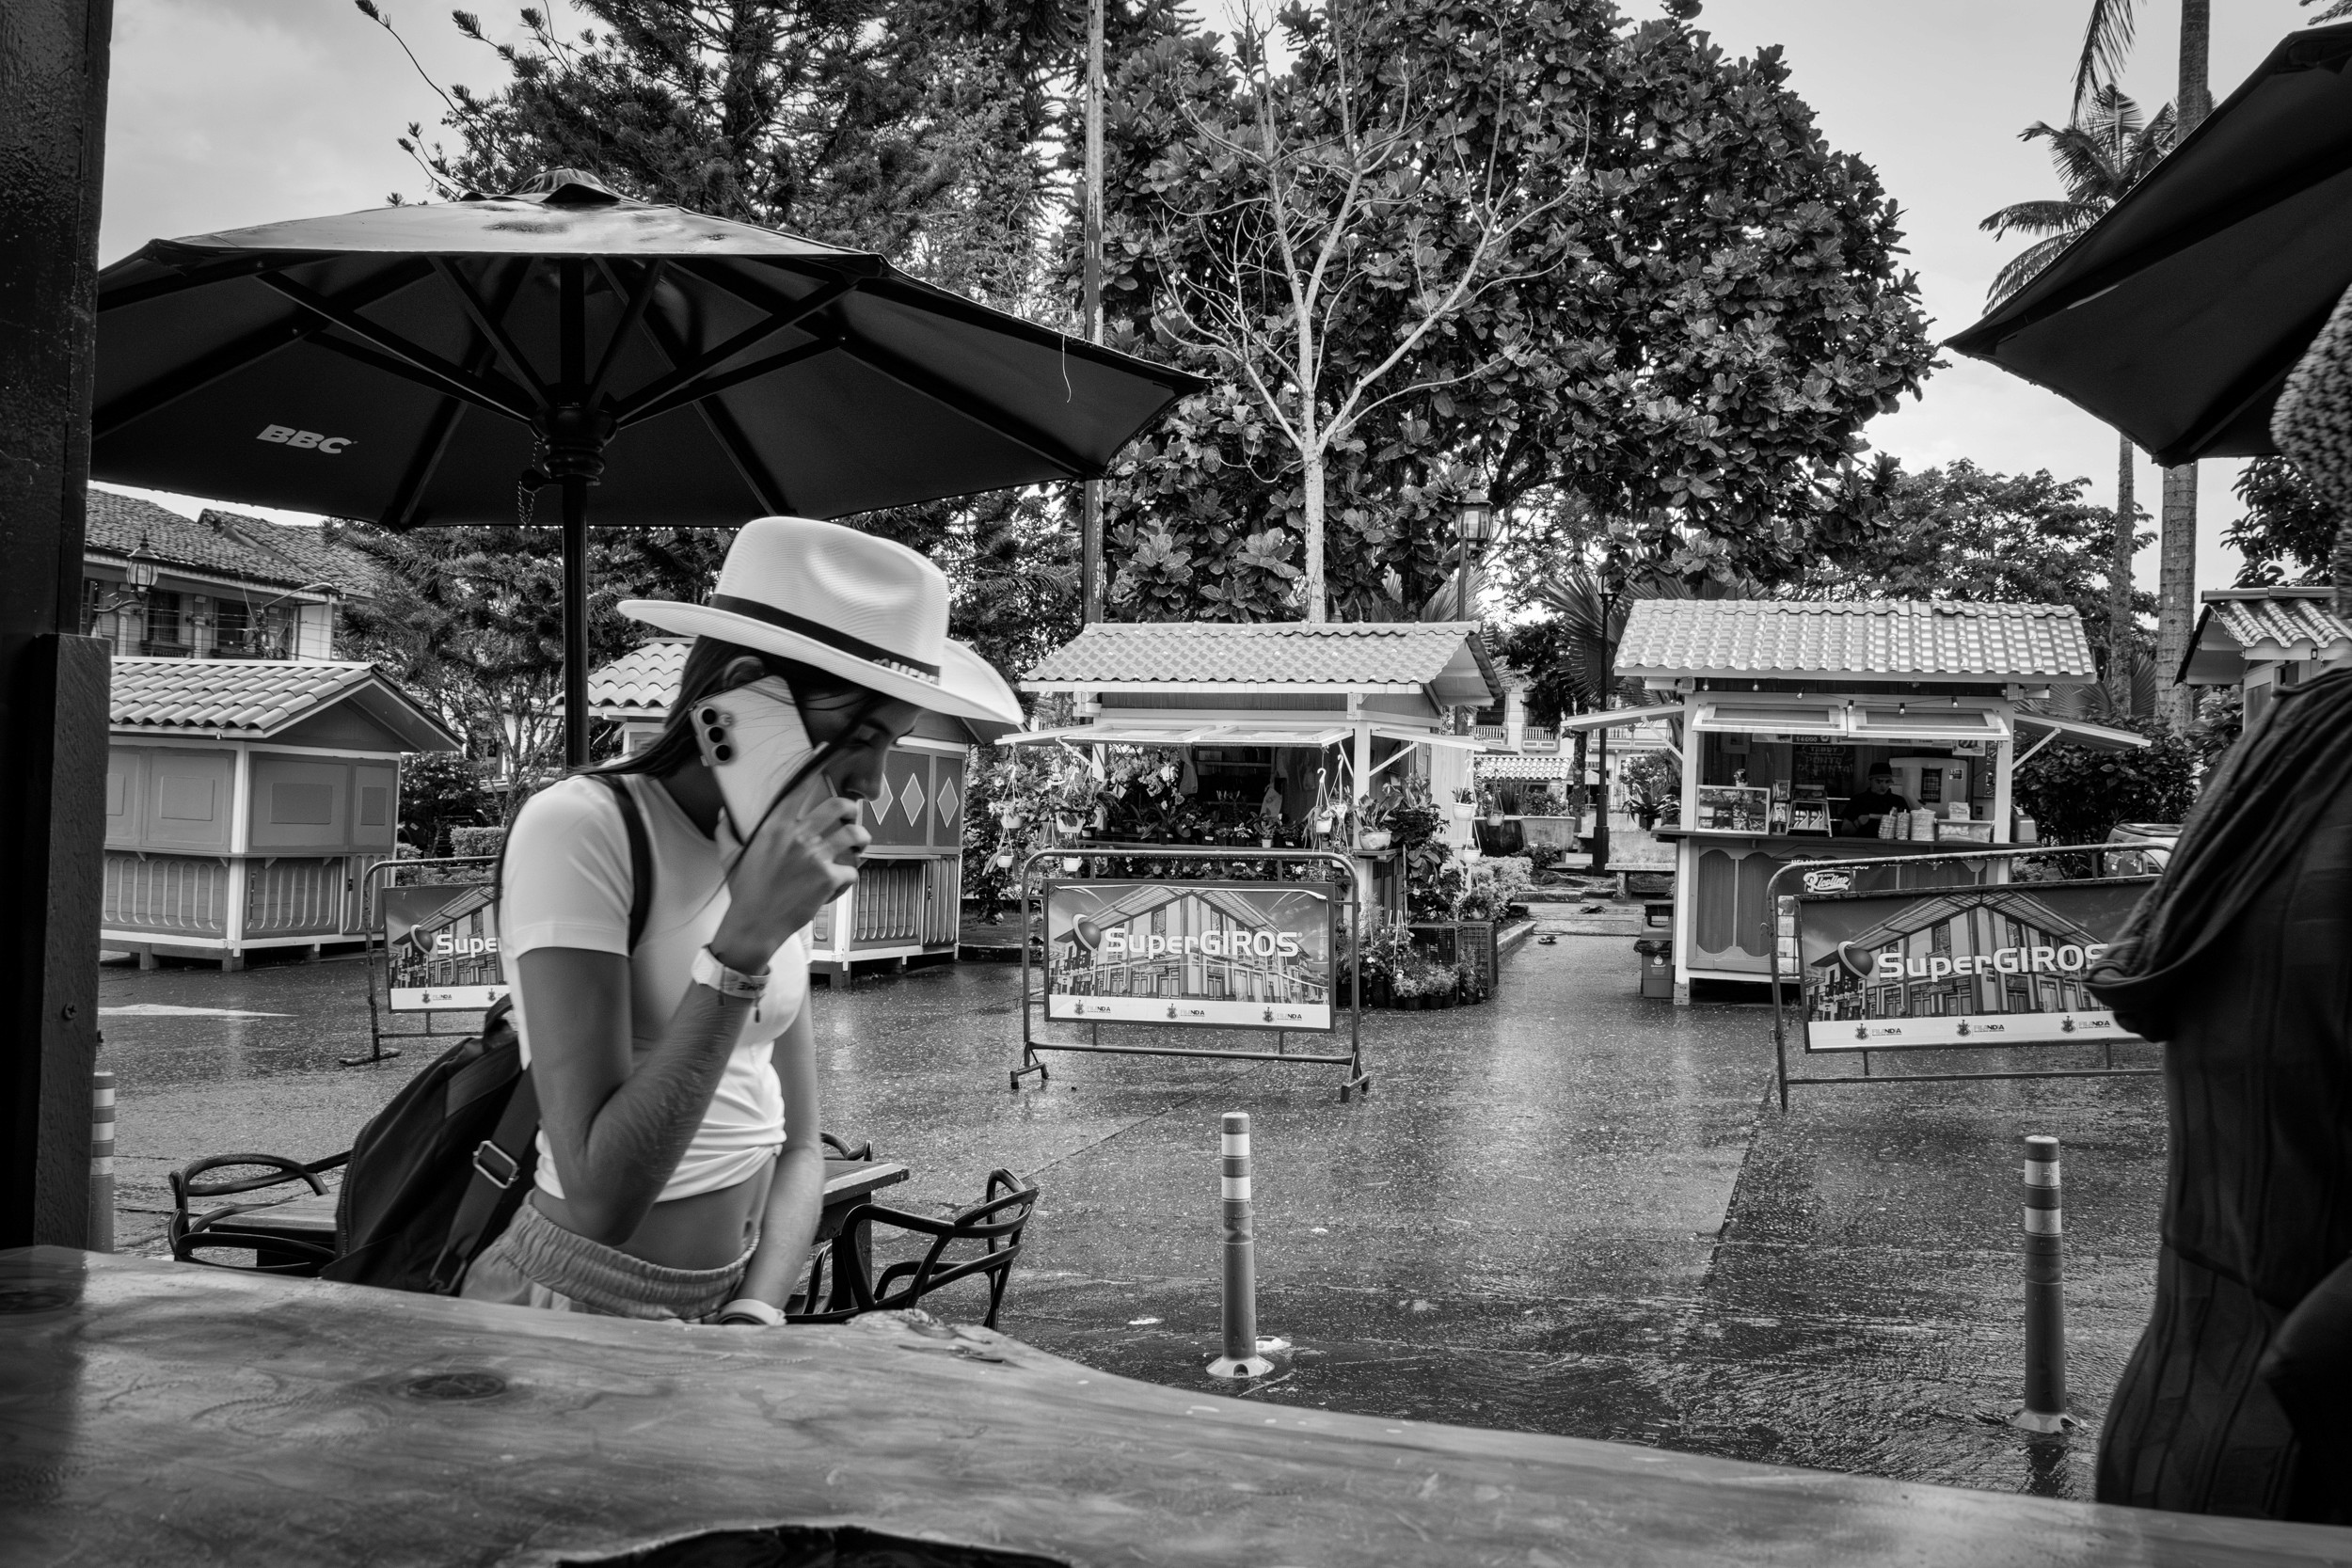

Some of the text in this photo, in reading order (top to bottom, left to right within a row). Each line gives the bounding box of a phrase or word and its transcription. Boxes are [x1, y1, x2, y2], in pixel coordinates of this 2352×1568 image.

[256, 423, 353, 454] BBC
[1104, 927, 1299, 959] SuperGIROS
[1878, 943, 2109, 982] SuperGIROS
